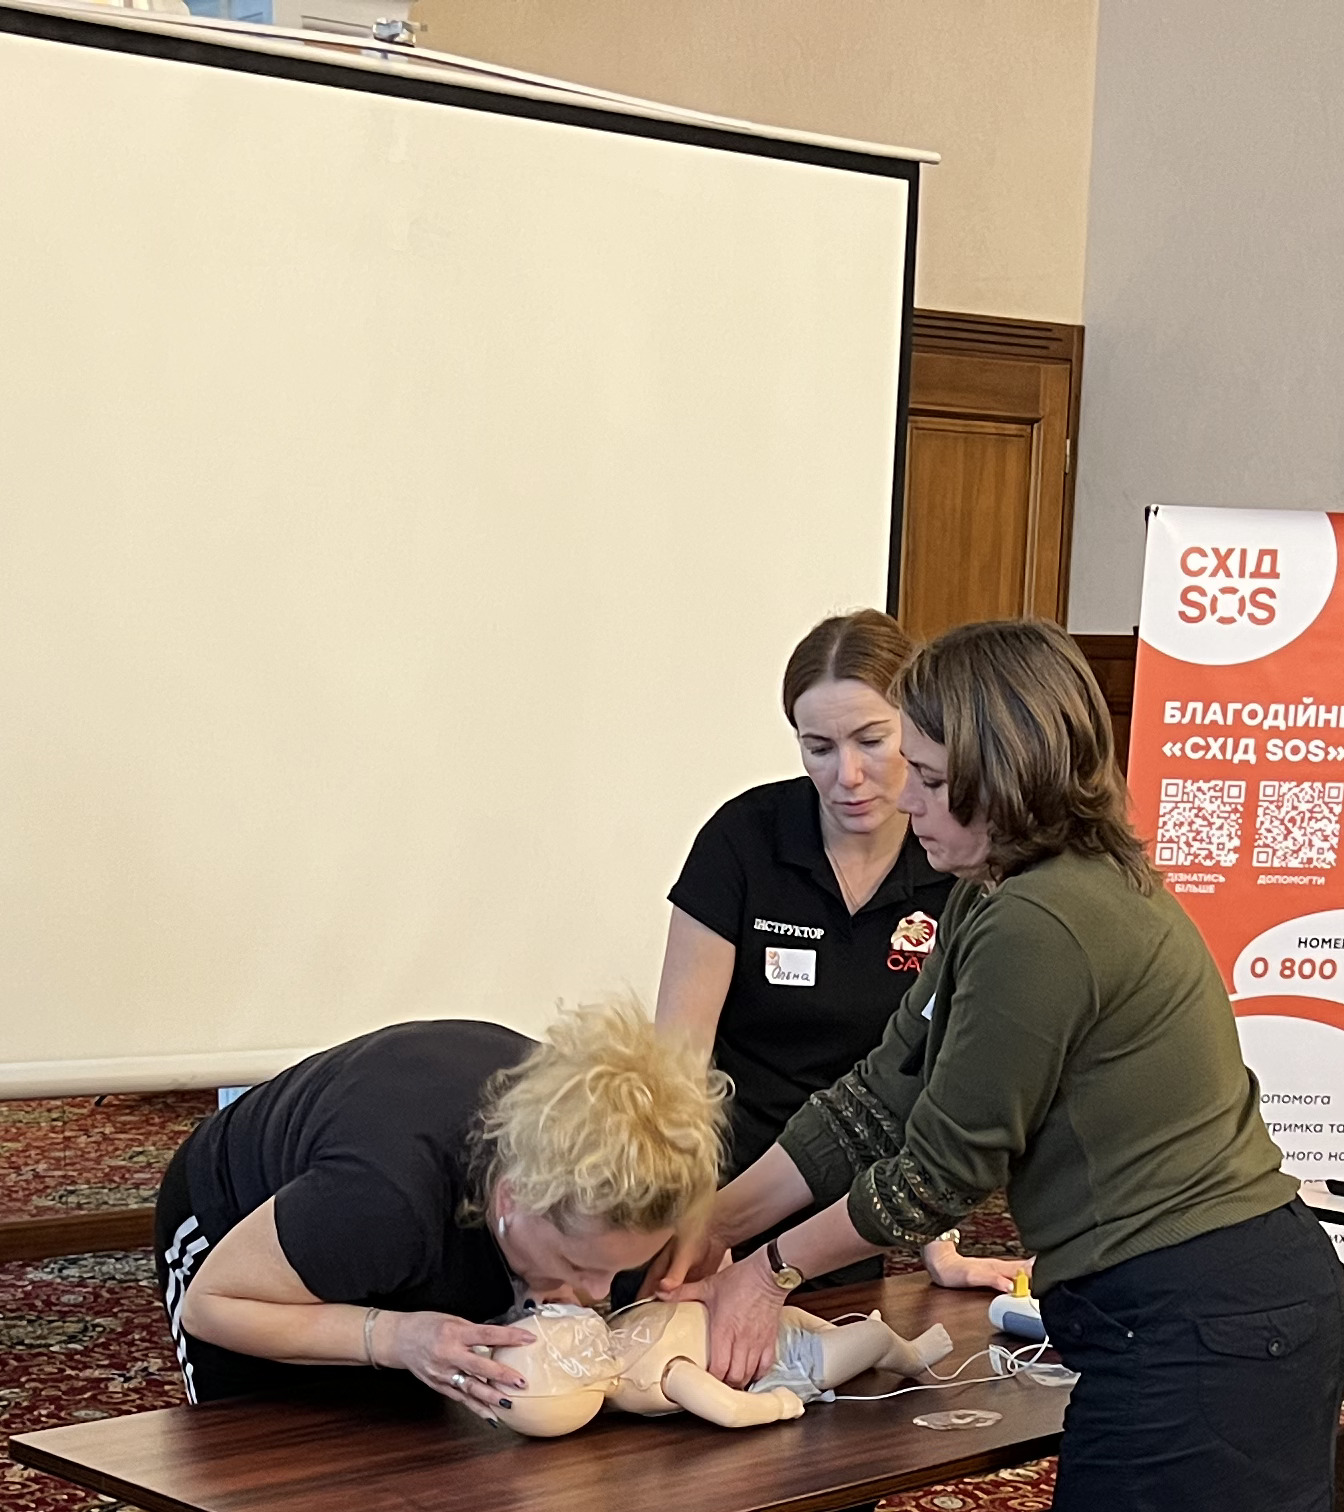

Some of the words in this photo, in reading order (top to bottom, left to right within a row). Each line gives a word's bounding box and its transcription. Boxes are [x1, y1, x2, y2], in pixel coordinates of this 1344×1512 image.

[1180, 546, 1280, 579] СХІД
[1178, 585, 1277, 626] SOS
[1161, 736, 1257, 765] «СХІД
[1257, 874, 1326, 886] ДОПОМОГТИ
[1175, 883, 1215, 894] БІЛЬШЕ
[887, 954, 921, 972] СА
[1250, 957, 1269, 978] 0
[1279, 957, 1338, 980] 800
[1260, 1094, 1331, 1105] опомога
[1265, 1121, 1323, 1136] тримка
[1285, 1150, 1323, 1162] ного
